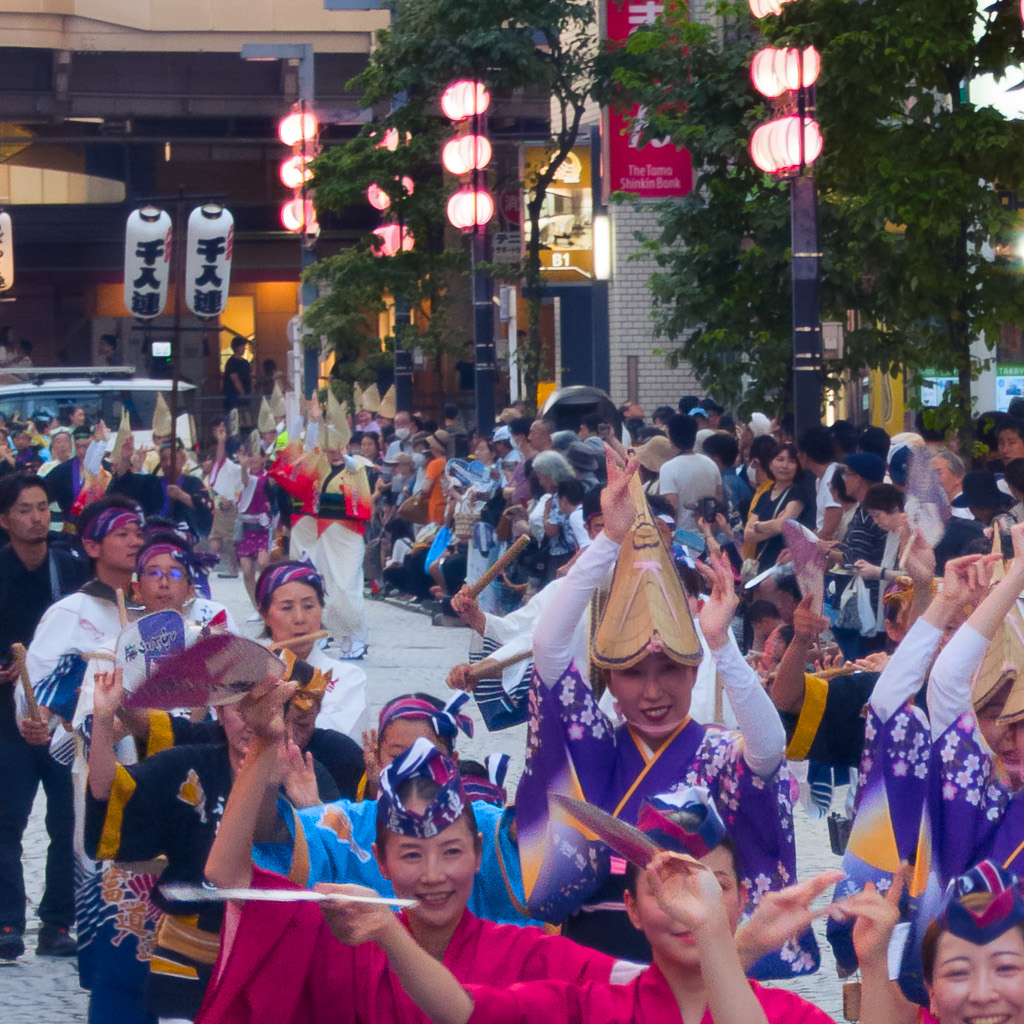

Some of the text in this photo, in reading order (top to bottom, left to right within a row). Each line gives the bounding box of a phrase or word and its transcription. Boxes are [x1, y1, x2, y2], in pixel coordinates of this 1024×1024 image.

[628, 165, 673, 176] The Tama
[620, 178, 681, 190] Shinkin Bank
[552, 252, 570, 267] B1
